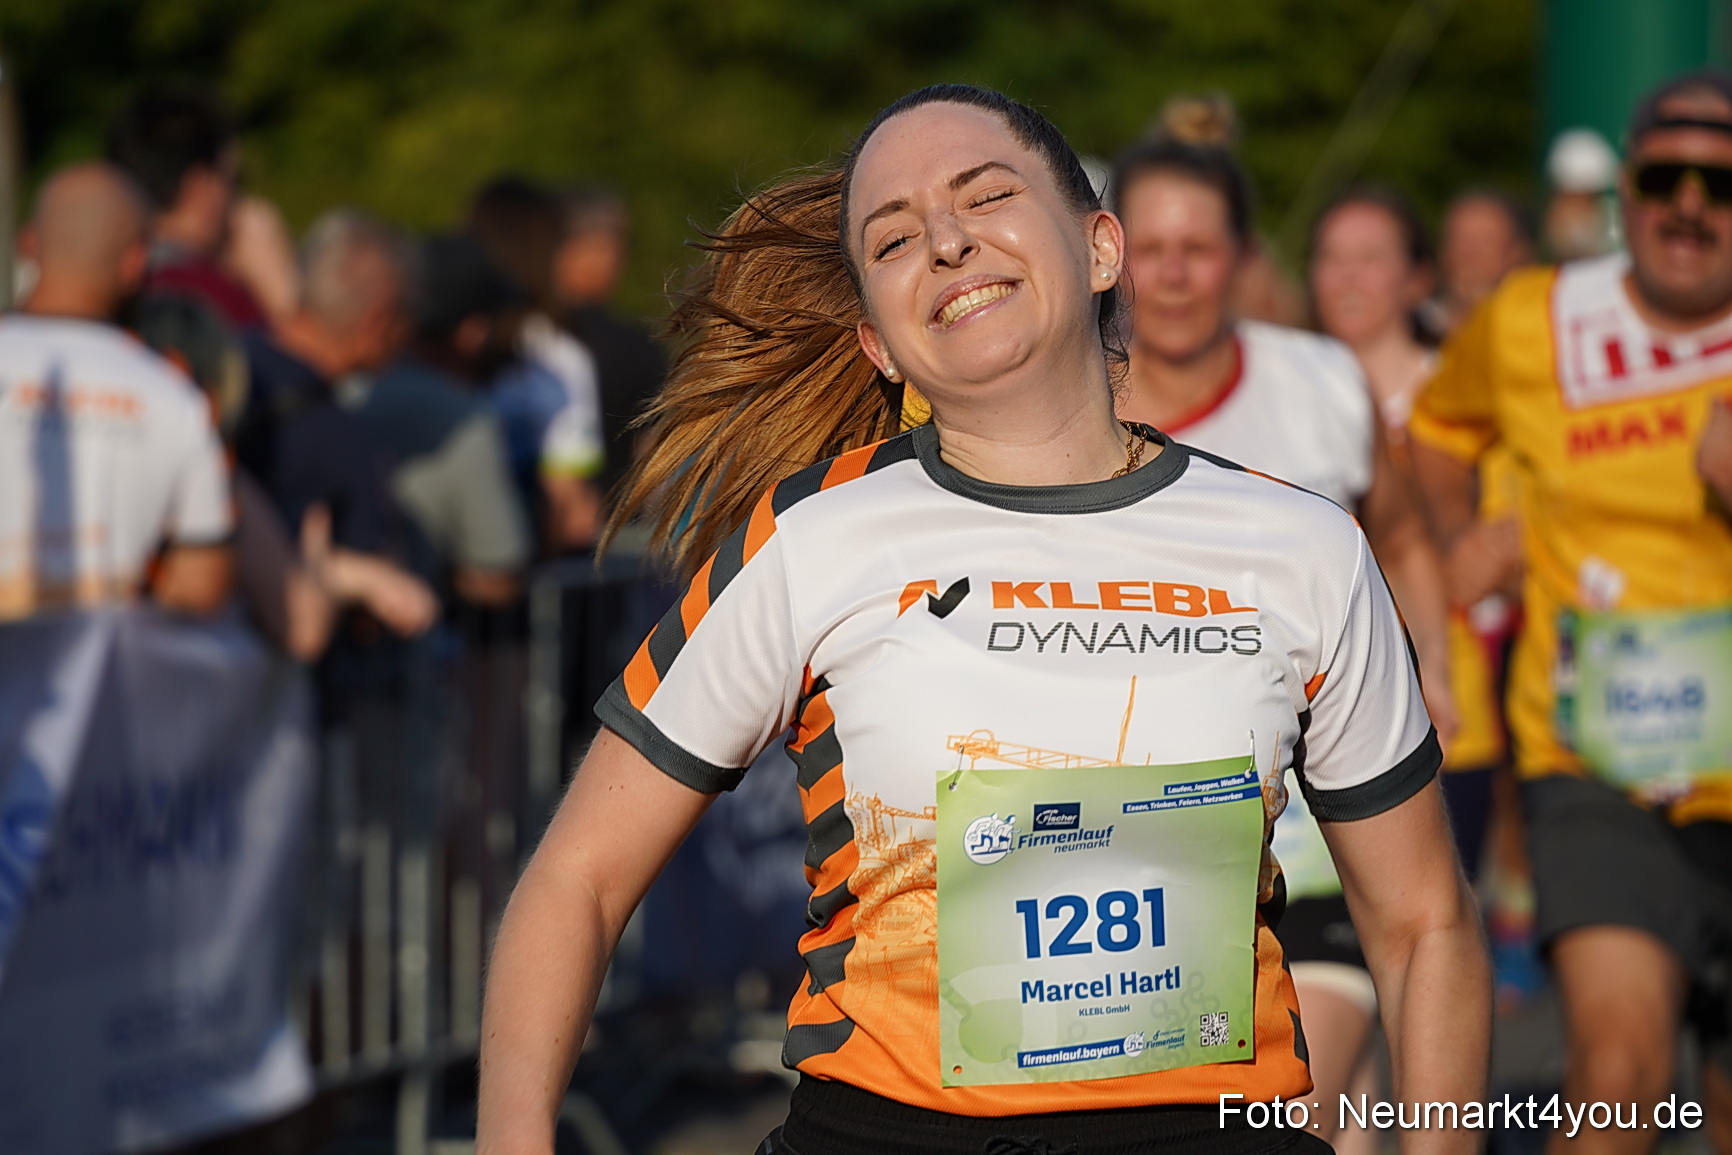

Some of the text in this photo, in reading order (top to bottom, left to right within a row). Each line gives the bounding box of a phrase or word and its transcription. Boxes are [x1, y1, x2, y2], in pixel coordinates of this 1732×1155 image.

[991, 581, 1259, 617] KLEBL
[987, 621, 1262, 656] DYNAMICS
[1167, 776, 1245, 794] Laufen, Joggen, Walken
[1126, 792, 1243, 812] Essen, Trinken, Feiern, Netzwerken
[1017, 825, 1114, 849] Firmenlauf
[1053, 838, 1110, 854] neumarkt
[1016, 888, 1165, 959] 1281
[1021, 966, 1181, 1004] Marcel Hartl
[1079, 1004, 1130, 1017] KLEBL GmbH
[1146, 1034, 1185, 1049] Firmenlauf
[1022, 1044, 1119, 1066] firmenlauf.bayern
